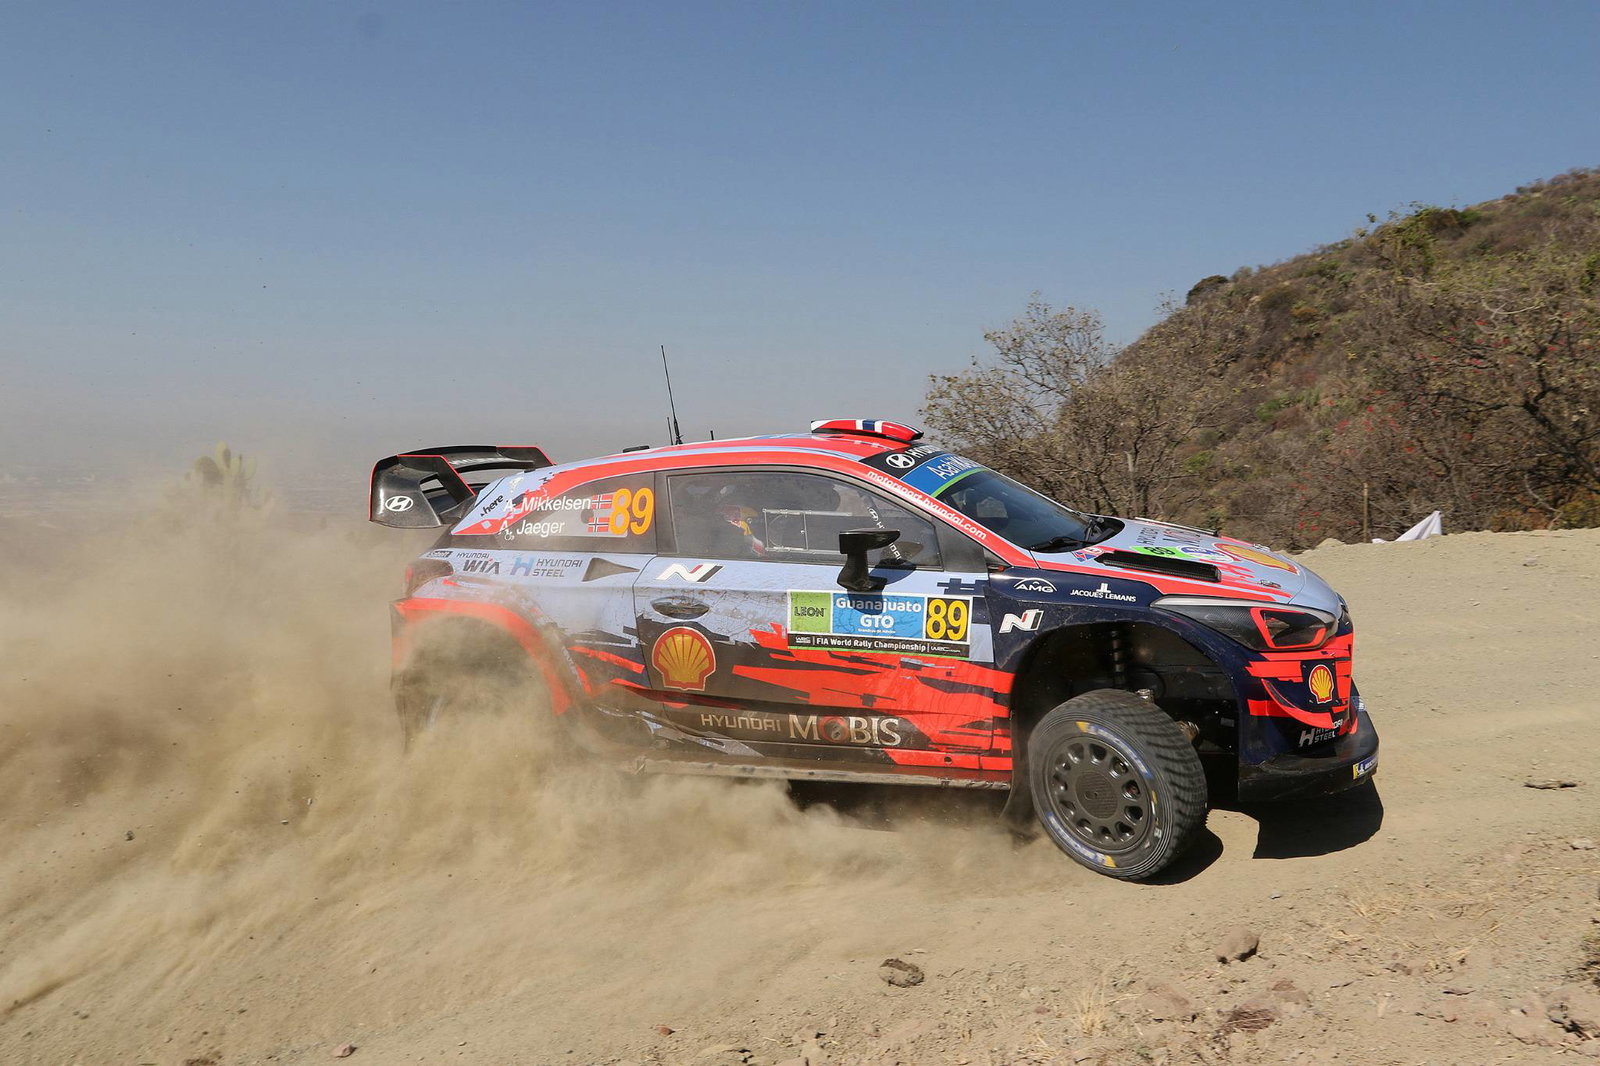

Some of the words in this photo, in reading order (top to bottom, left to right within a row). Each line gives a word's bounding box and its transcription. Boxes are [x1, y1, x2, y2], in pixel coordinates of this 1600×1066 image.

[483, 494, 504, 515] here
[521, 496, 592, 511] Mikkelsen
[608, 487, 654, 536] 89
[866, 470, 988, 540] motorsport.hyundai.com
[517, 520, 565, 538] Jaeger
[462, 558, 500, 575] WIA
[536, 558, 583, 568] HYUNDAI
[532, 568, 565, 578] STEEL
[1015, 583, 1054, 593] AMG
[1070, 589, 1104, 599] JACQUES
[1105, 591, 1137, 602] LEMANS
[836, 597, 922, 613] Guanajuato
[859, 615, 895, 629] GTO
[926, 598, 968, 641] 89
[816, 638, 829, 646] FIA
[830, 638, 852, 647] World
[853, 640, 873, 649] Rally
[874, 640, 926, 653] Championship
[701, 713, 781, 732] HYUNDAI
[788, 713, 902, 747] MOBIS
